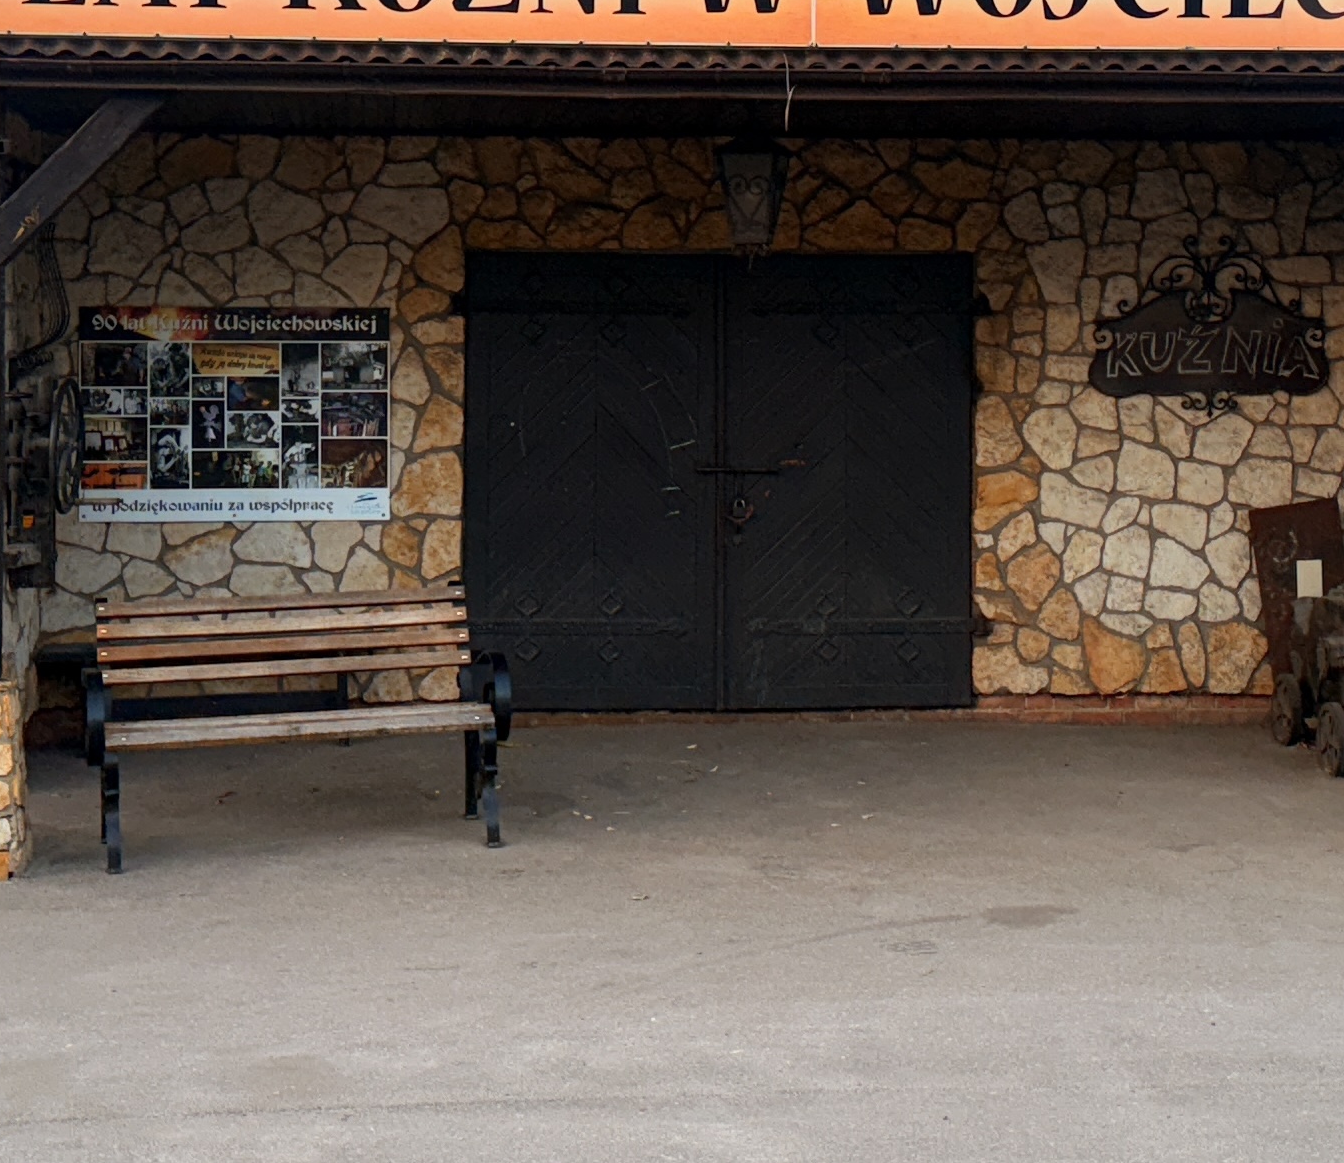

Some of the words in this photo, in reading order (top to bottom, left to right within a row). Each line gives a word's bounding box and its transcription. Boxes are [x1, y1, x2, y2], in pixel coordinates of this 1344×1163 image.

[91, 315, 117, 331] 90
[122, 315, 146, 331] lat
[111, 497, 223, 515] podziękowaniu
[228, 501, 244, 511] za
[249, 498, 334, 515] współpracę
